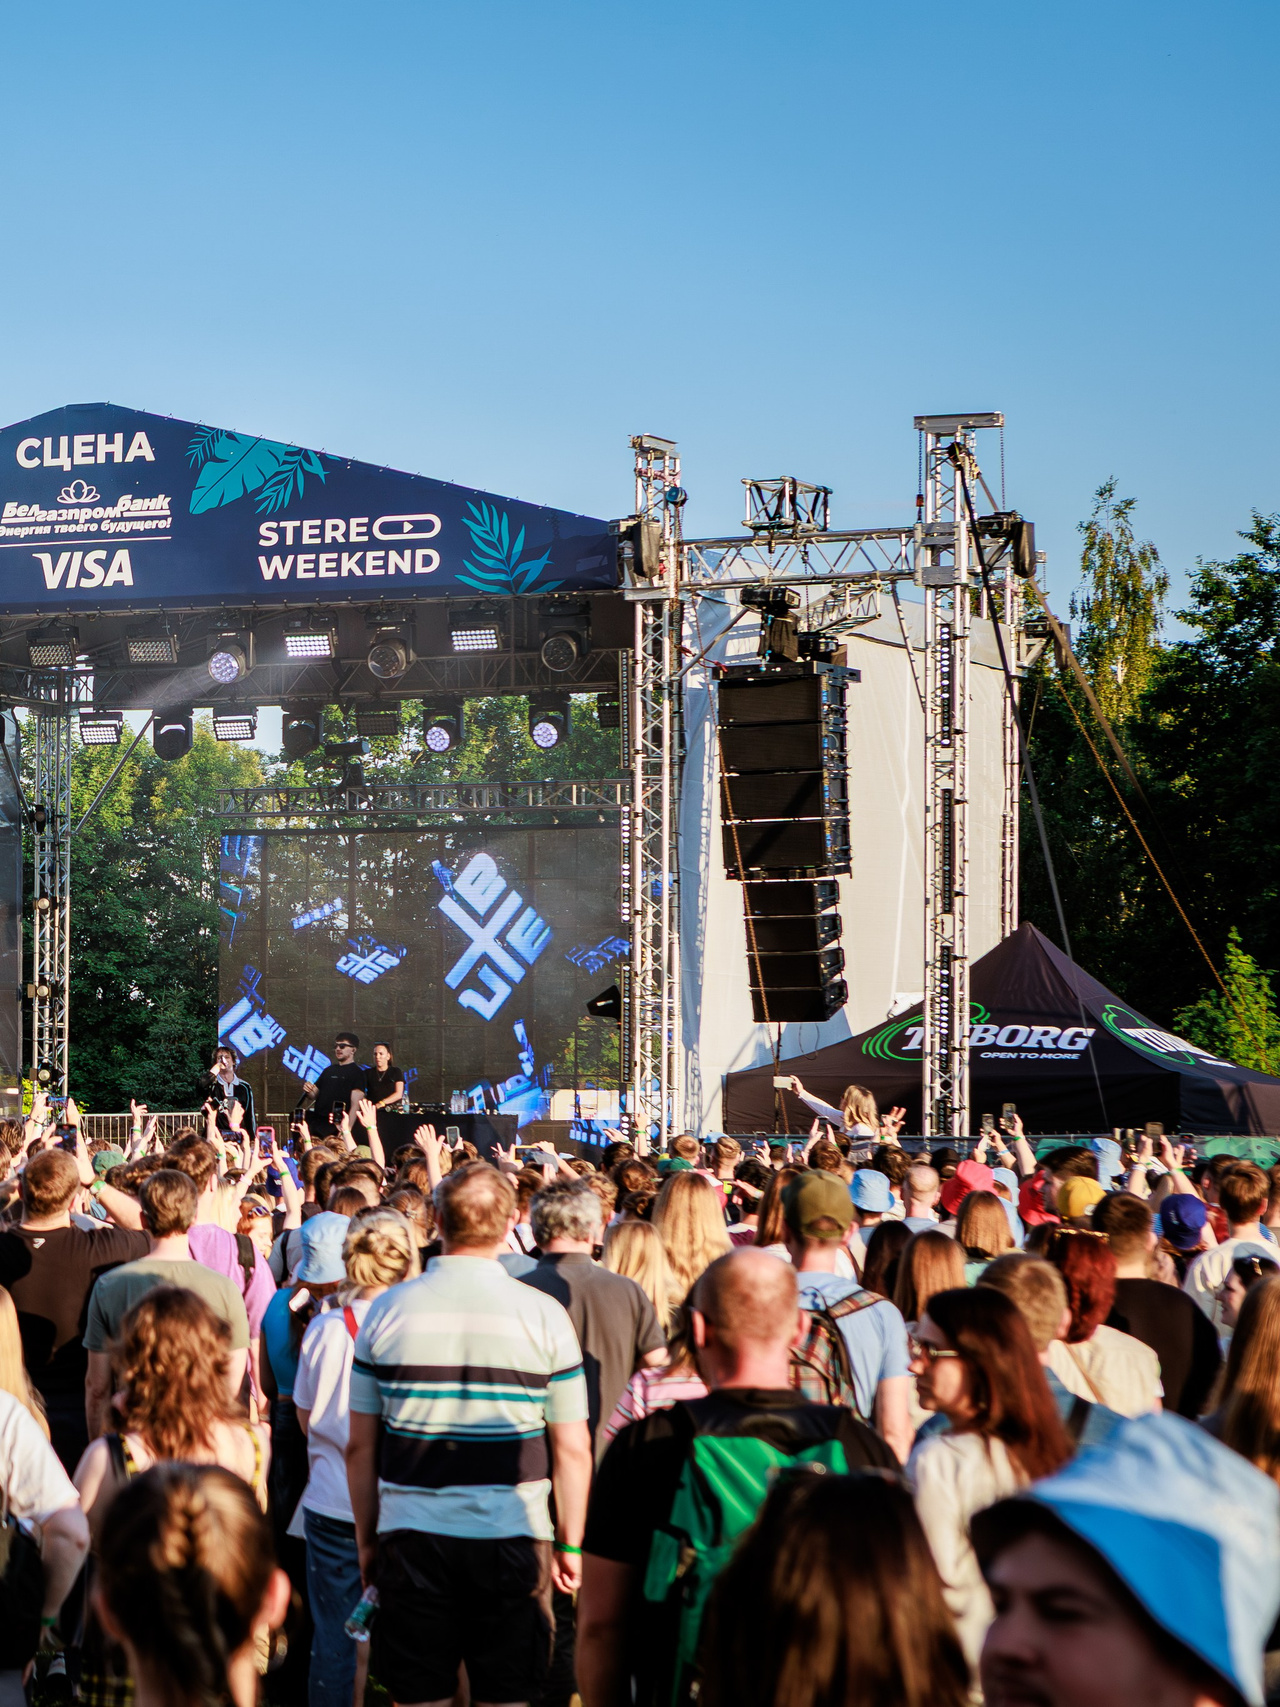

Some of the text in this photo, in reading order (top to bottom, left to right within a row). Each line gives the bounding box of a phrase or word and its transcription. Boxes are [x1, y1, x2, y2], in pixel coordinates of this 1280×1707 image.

[16, 431, 156, 472] СЦЕНА
[1, 494, 172, 523] Белгазпромбанк
[54, 522, 99, 534] твоего
[100, 517, 172, 534] будущего!
[32, 548, 134, 590] VISA
[257, 548, 441, 581] WEEKEND
[901, 1024, 1096, 1050] TBORG
